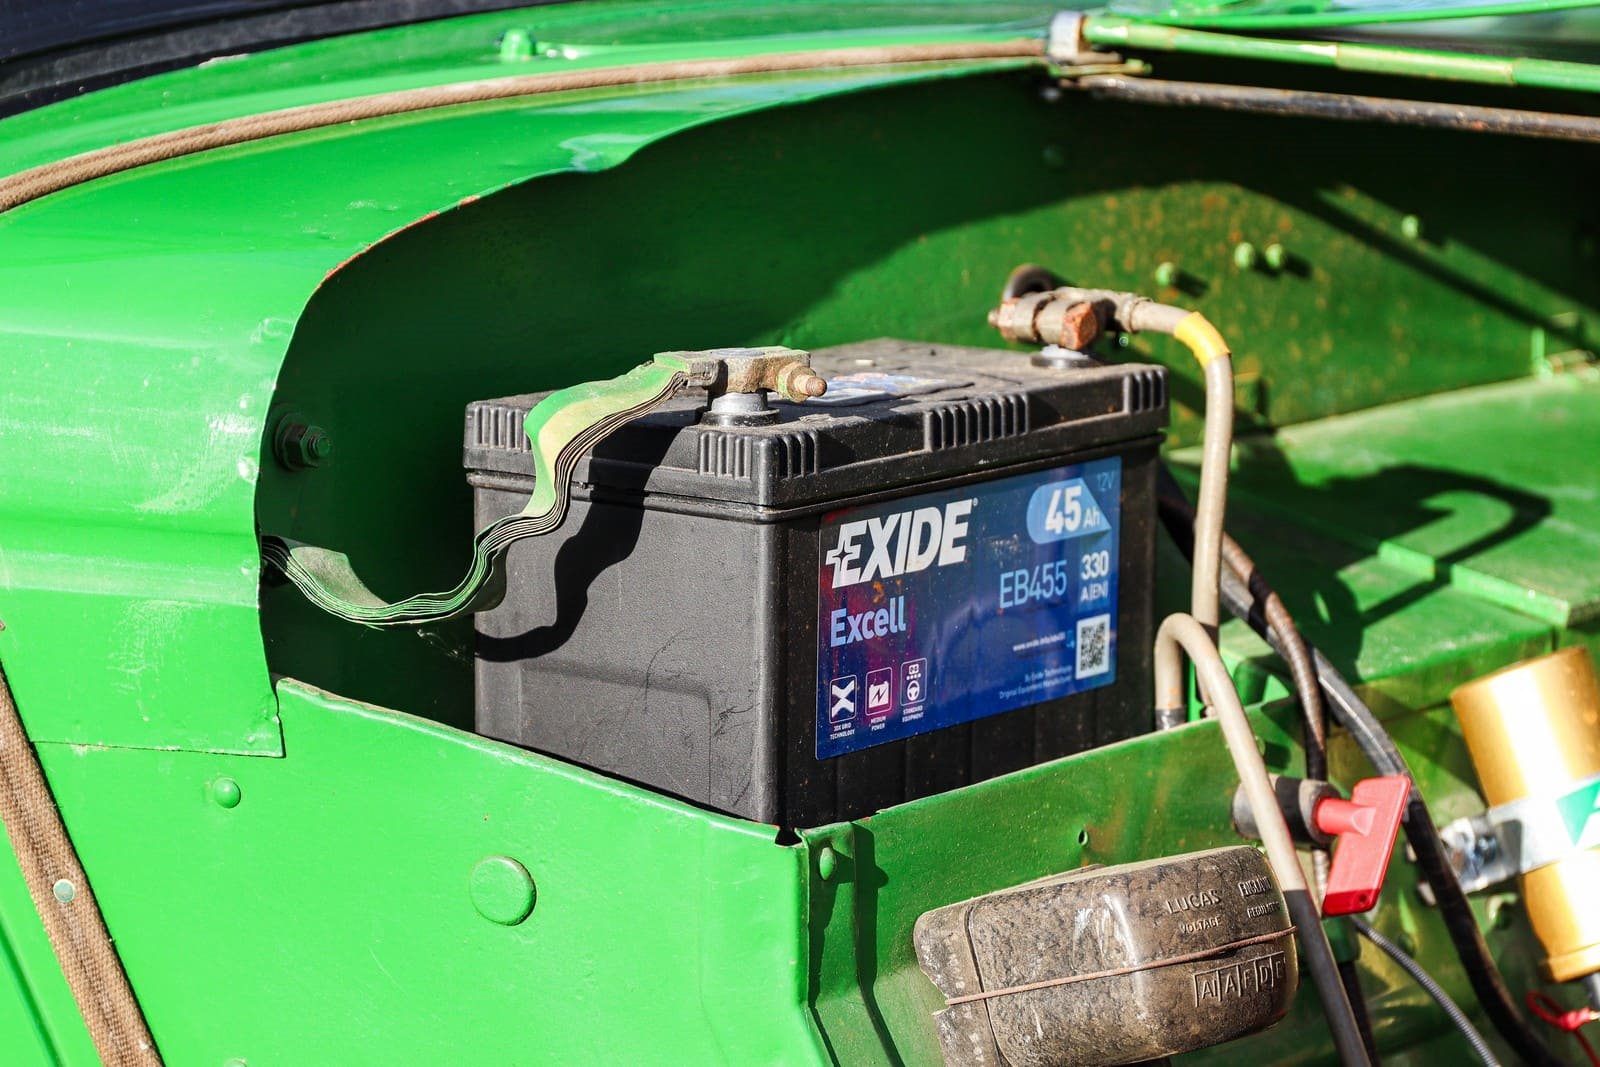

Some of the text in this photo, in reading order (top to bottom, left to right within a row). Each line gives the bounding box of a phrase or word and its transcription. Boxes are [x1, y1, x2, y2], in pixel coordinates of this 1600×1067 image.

[1097, 471, 1114, 492] 12V
[1045, 485, 1100, 535] 45 Ah
[825, 499, 973, 589] EXIDE
[1081, 550, 1109, 580] 330
[1000, 560, 1067, 609] EB455
[830, 596, 906, 647] Excell
[830, 729, 855, 740] TECHNOLOGY
[871, 723, 885, 731] POWER
[1166, 888, 1221, 914] LUCAS
[1179, 916, 1221, 934] VOLTAGE
[1224, 972, 1238, 994] A
[1260, 964, 1269, 985] D
